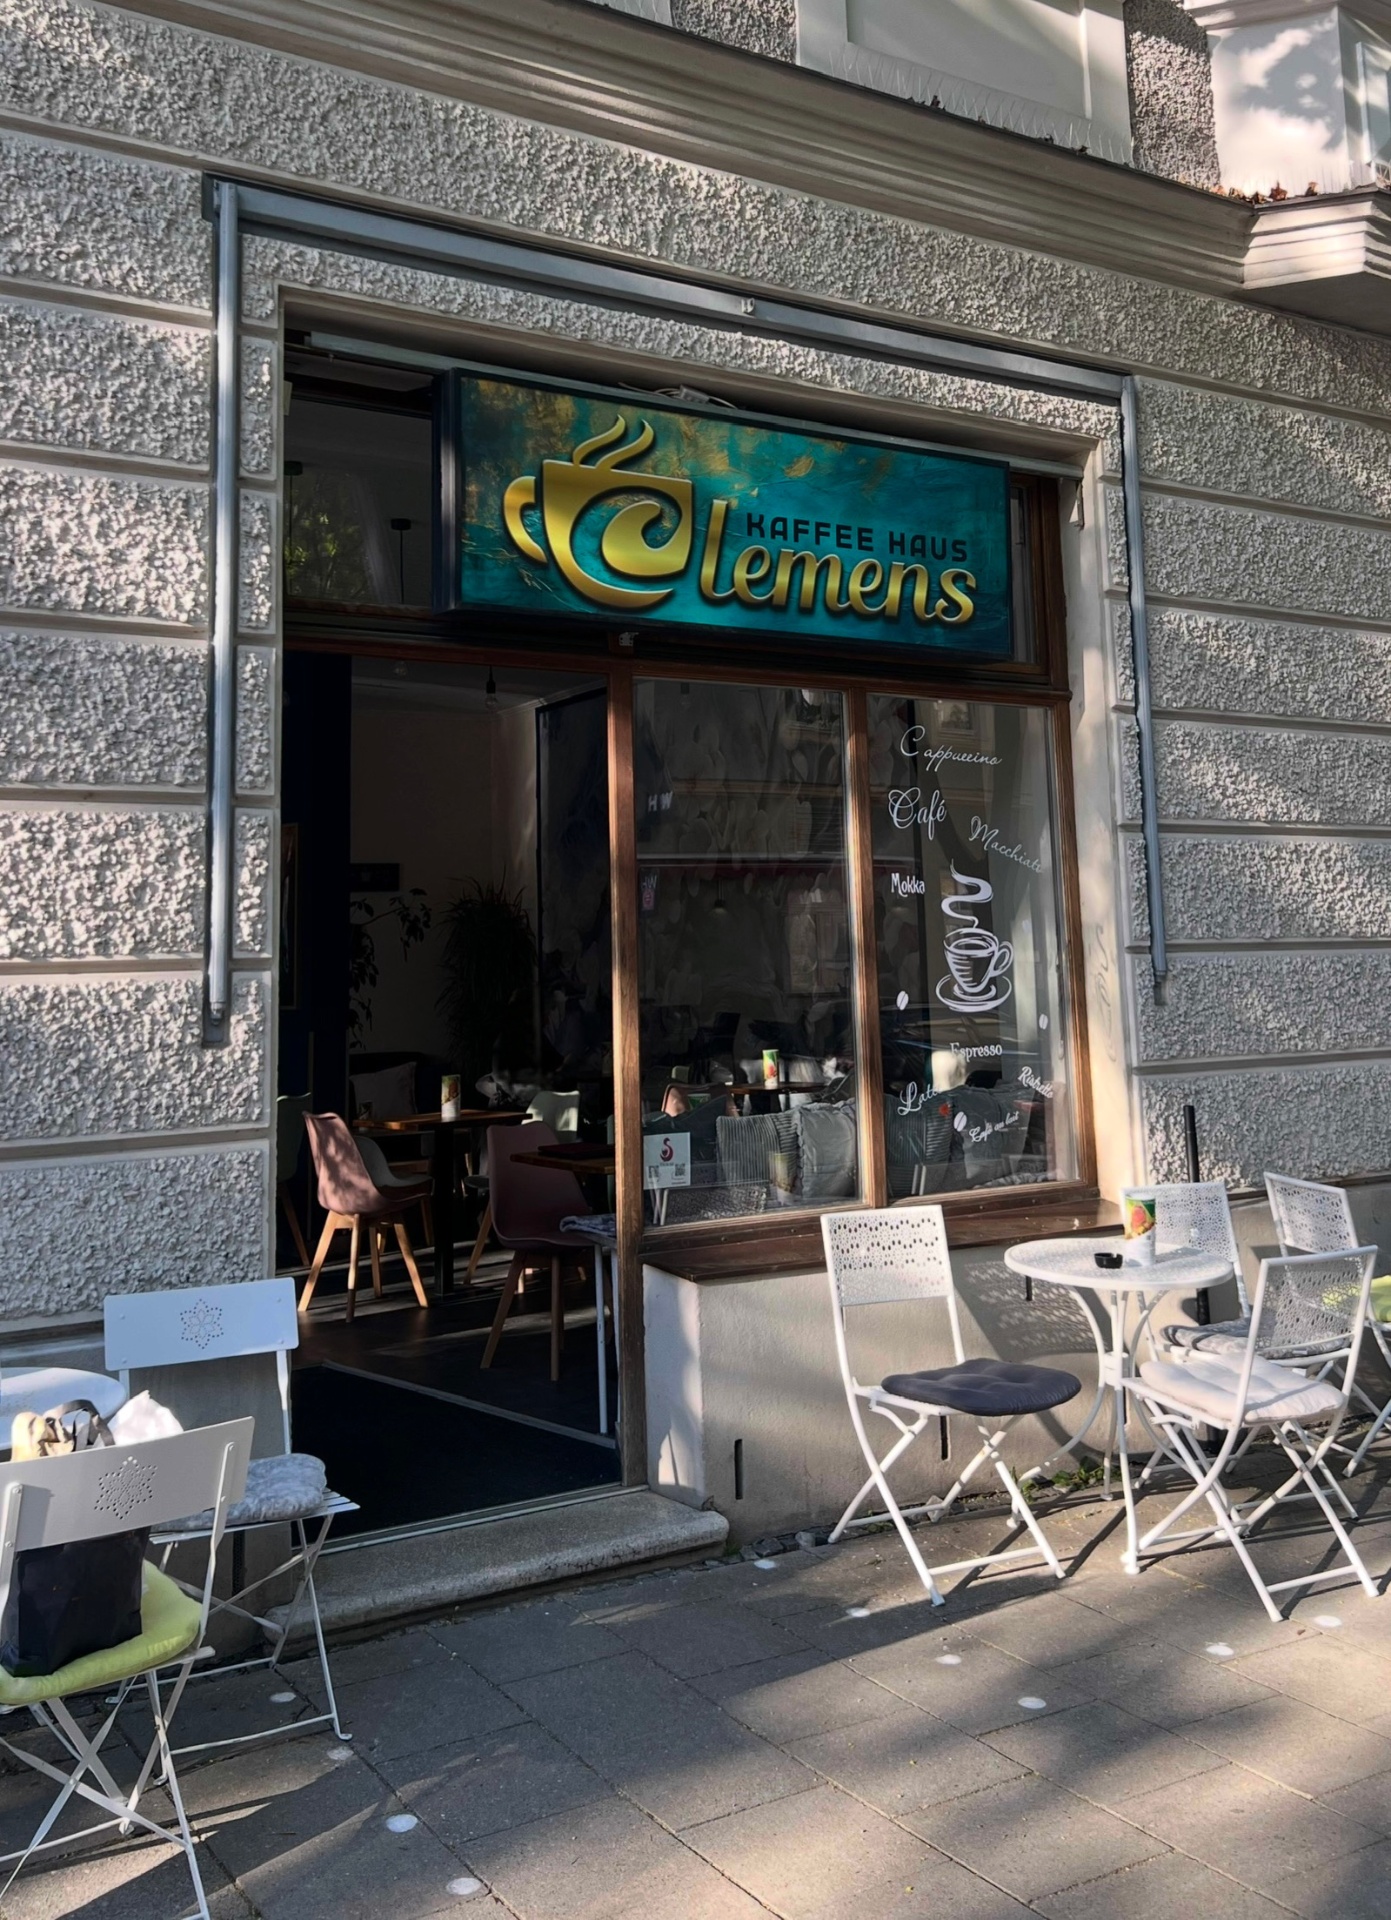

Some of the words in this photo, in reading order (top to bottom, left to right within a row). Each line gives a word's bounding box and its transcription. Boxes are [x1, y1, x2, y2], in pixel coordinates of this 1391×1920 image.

[745, 512, 874, 552] KAFFEE
[888, 531, 969, 563] HAUS
[900, 725, 1002, 772] Cappuccino
[888, 787, 947, 840] Café
[968, 815, 1043, 873] Macchiato
[891, 872, 925, 898] Mokka
[949, 1042, 1003, 1063] Espresso
[1017, 1065, 1053, 1099] Ristretto
